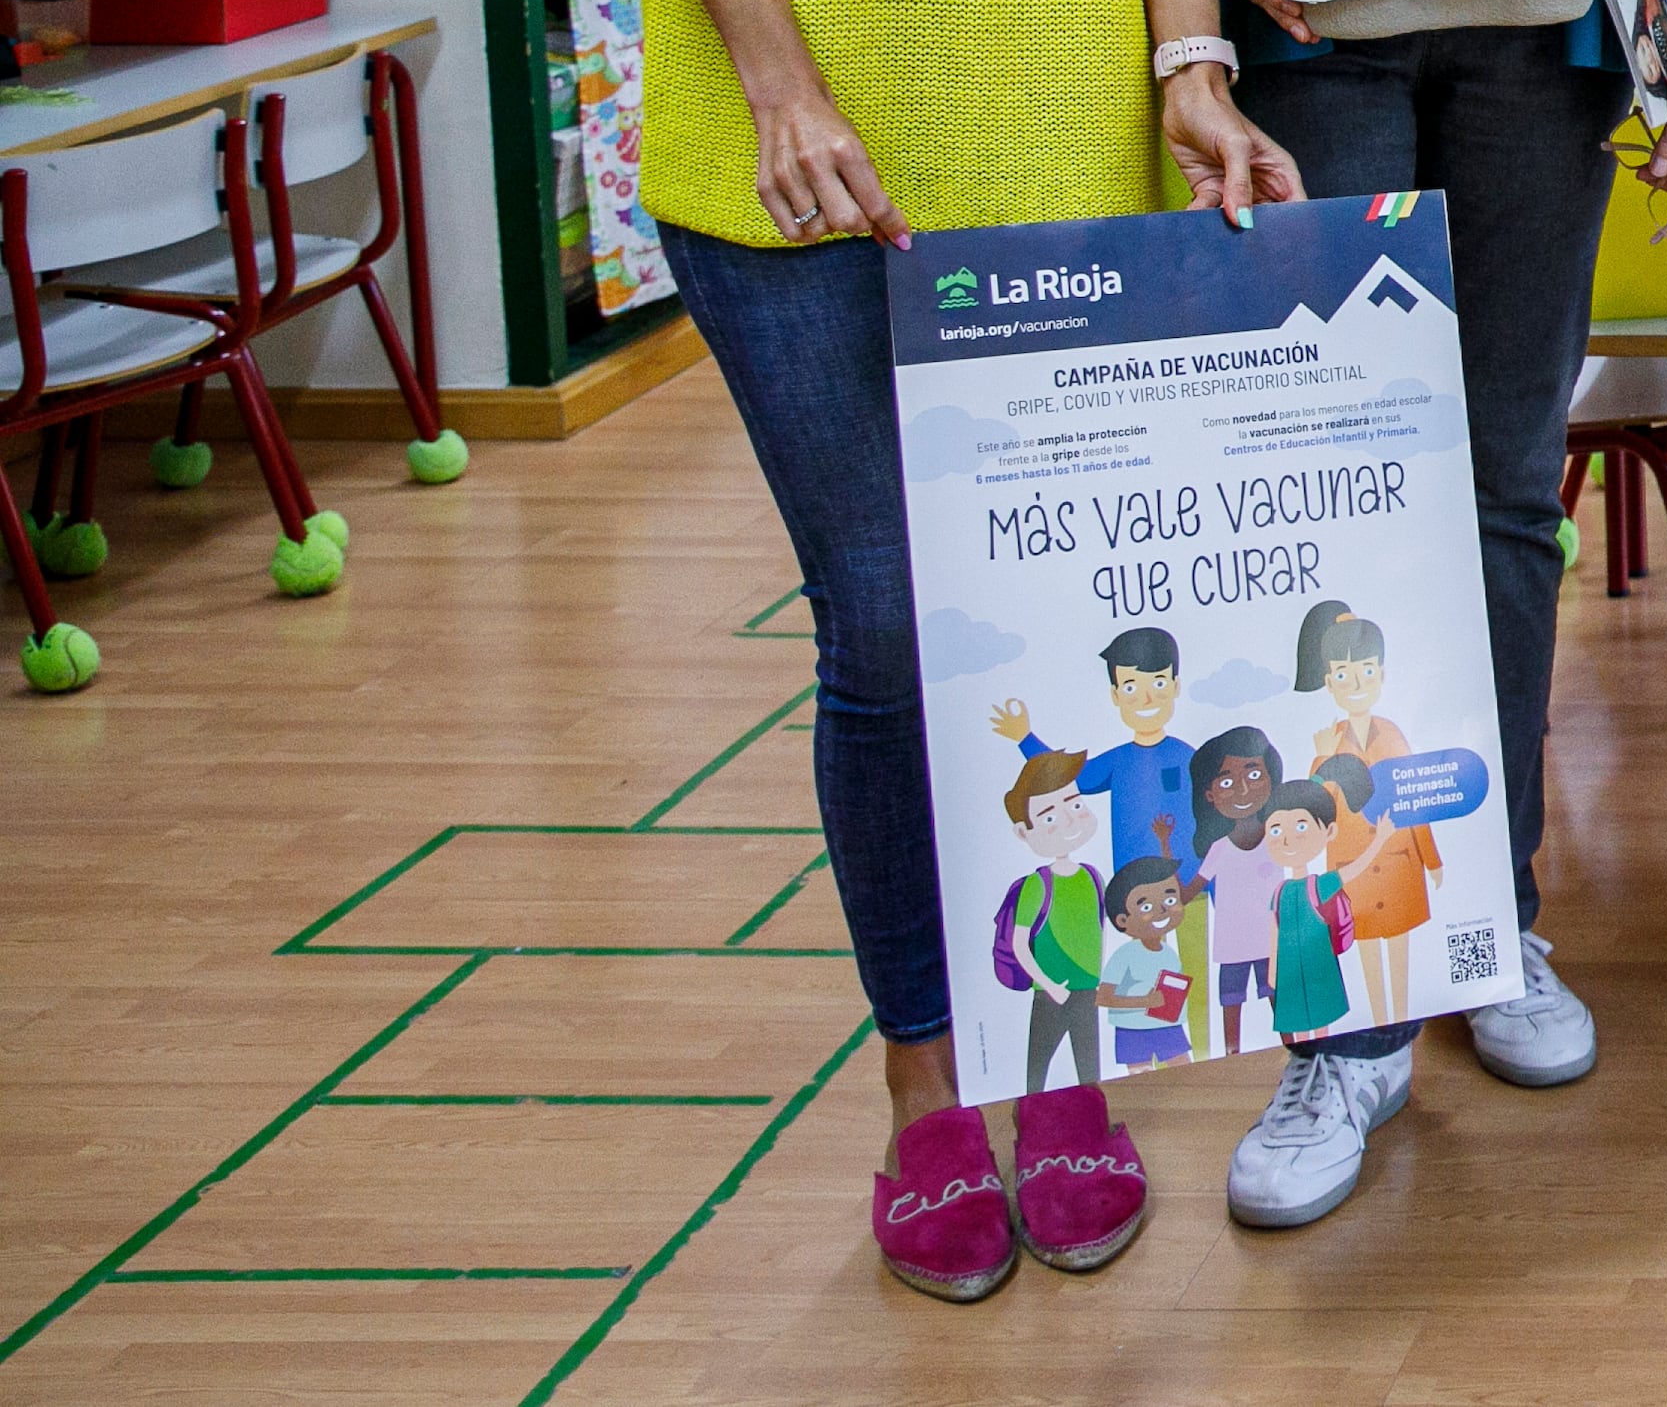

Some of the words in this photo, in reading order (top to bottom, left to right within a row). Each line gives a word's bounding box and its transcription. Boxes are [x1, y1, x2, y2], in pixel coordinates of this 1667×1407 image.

[989, 273, 1030, 305] La
[1035, 263, 1123, 302] Rioja
[940, 315, 1089, 341] larioja.org/vacunacion
[1054, 357, 1155, 388] CAMPAÑA
[1160, 358, 1187, 378] DE
[1191, 341, 1319, 374] VACUNACIÓN
[1007, 396, 1059, 417] GRIPE,
[1063, 391, 1111, 411] COVID
[1115, 389, 1124, 405] Y
[1129, 384, 1177, 404] VIRUS
[1180, 372, 1290, 398] RESPIRATORIO
[1294, 364, 1367, 387] SINCITIAL
[1202, 418, 1230, 428] Como
[1232, 411, 1277, 424] novedad
[1279, 409, 1300, 420] para
[1302, 407, 1316, 417] los
[1318, 404, 1359, 415] menores
[1361, 401, 1372, 410] en
[1374, 398, 1397, 409] edad
[1399, 394, 1432, 406] escolar
[977, 442, 998, 453] Este
[1002, 441, 1020, 450] año
[1076, 431, 1086, 442] la
[1088, 425, 1147, 443] protección
[1223, 444, 1264, 457] Centros
[1265, 441, 1278, 452] de
[1279, 435, 1331, 450] Educación
[1332, 430, 1367, 444] Infantil
[1368, 431, 1375, 442] y
[1376, 425, 1420, 439] Primaria.
[1239, 431, 1247, 439] la
[1249, 422, 1309, 438] vacunación
[1311, 422, 1323, 432] se
[1325, 415, 1370, 430] realizará
[1371, 416, 1383, 425] en
[1386, 415, 1401, 423] sus
[975, 474, 983, 485] 6
[984, 472, 1020, 484] meses
[1022, 468, 1052, 480] hasta
[1053, 465, 1070, 476] los
[1071, 463, 1081, 474] 11
[1082, 461, 1108, 473] años
[1110, 459, 1123, 470] de
[1125, 455, 1153, 468] edad.
[999, 456, 1029, 466] frente
[1032, 455, 1038, 463] a
[1041, 453, 1050, 462] la
[1051, 448, 1080, 464] gripe
[1082, 446, 1112, 457] desde
[988, 491, 1076, 561] Más
[1092, 486, 1201, 550] vale
[1216, 461, 1406, 534] vacunar
[1092, 560, 1173, 619] que
[1191, 541, 1321, 606] curar
[1392, 768, 1415, 781] Con
[1416, 761, 1459, 777] vacuna
[1396, 775, 1458, 795] intranasal,
[1392, 799, 1411, 813] sin
[1412, 791, 1464, 811] pinchazo
[1016, 1154, 1148, 1191] amore
